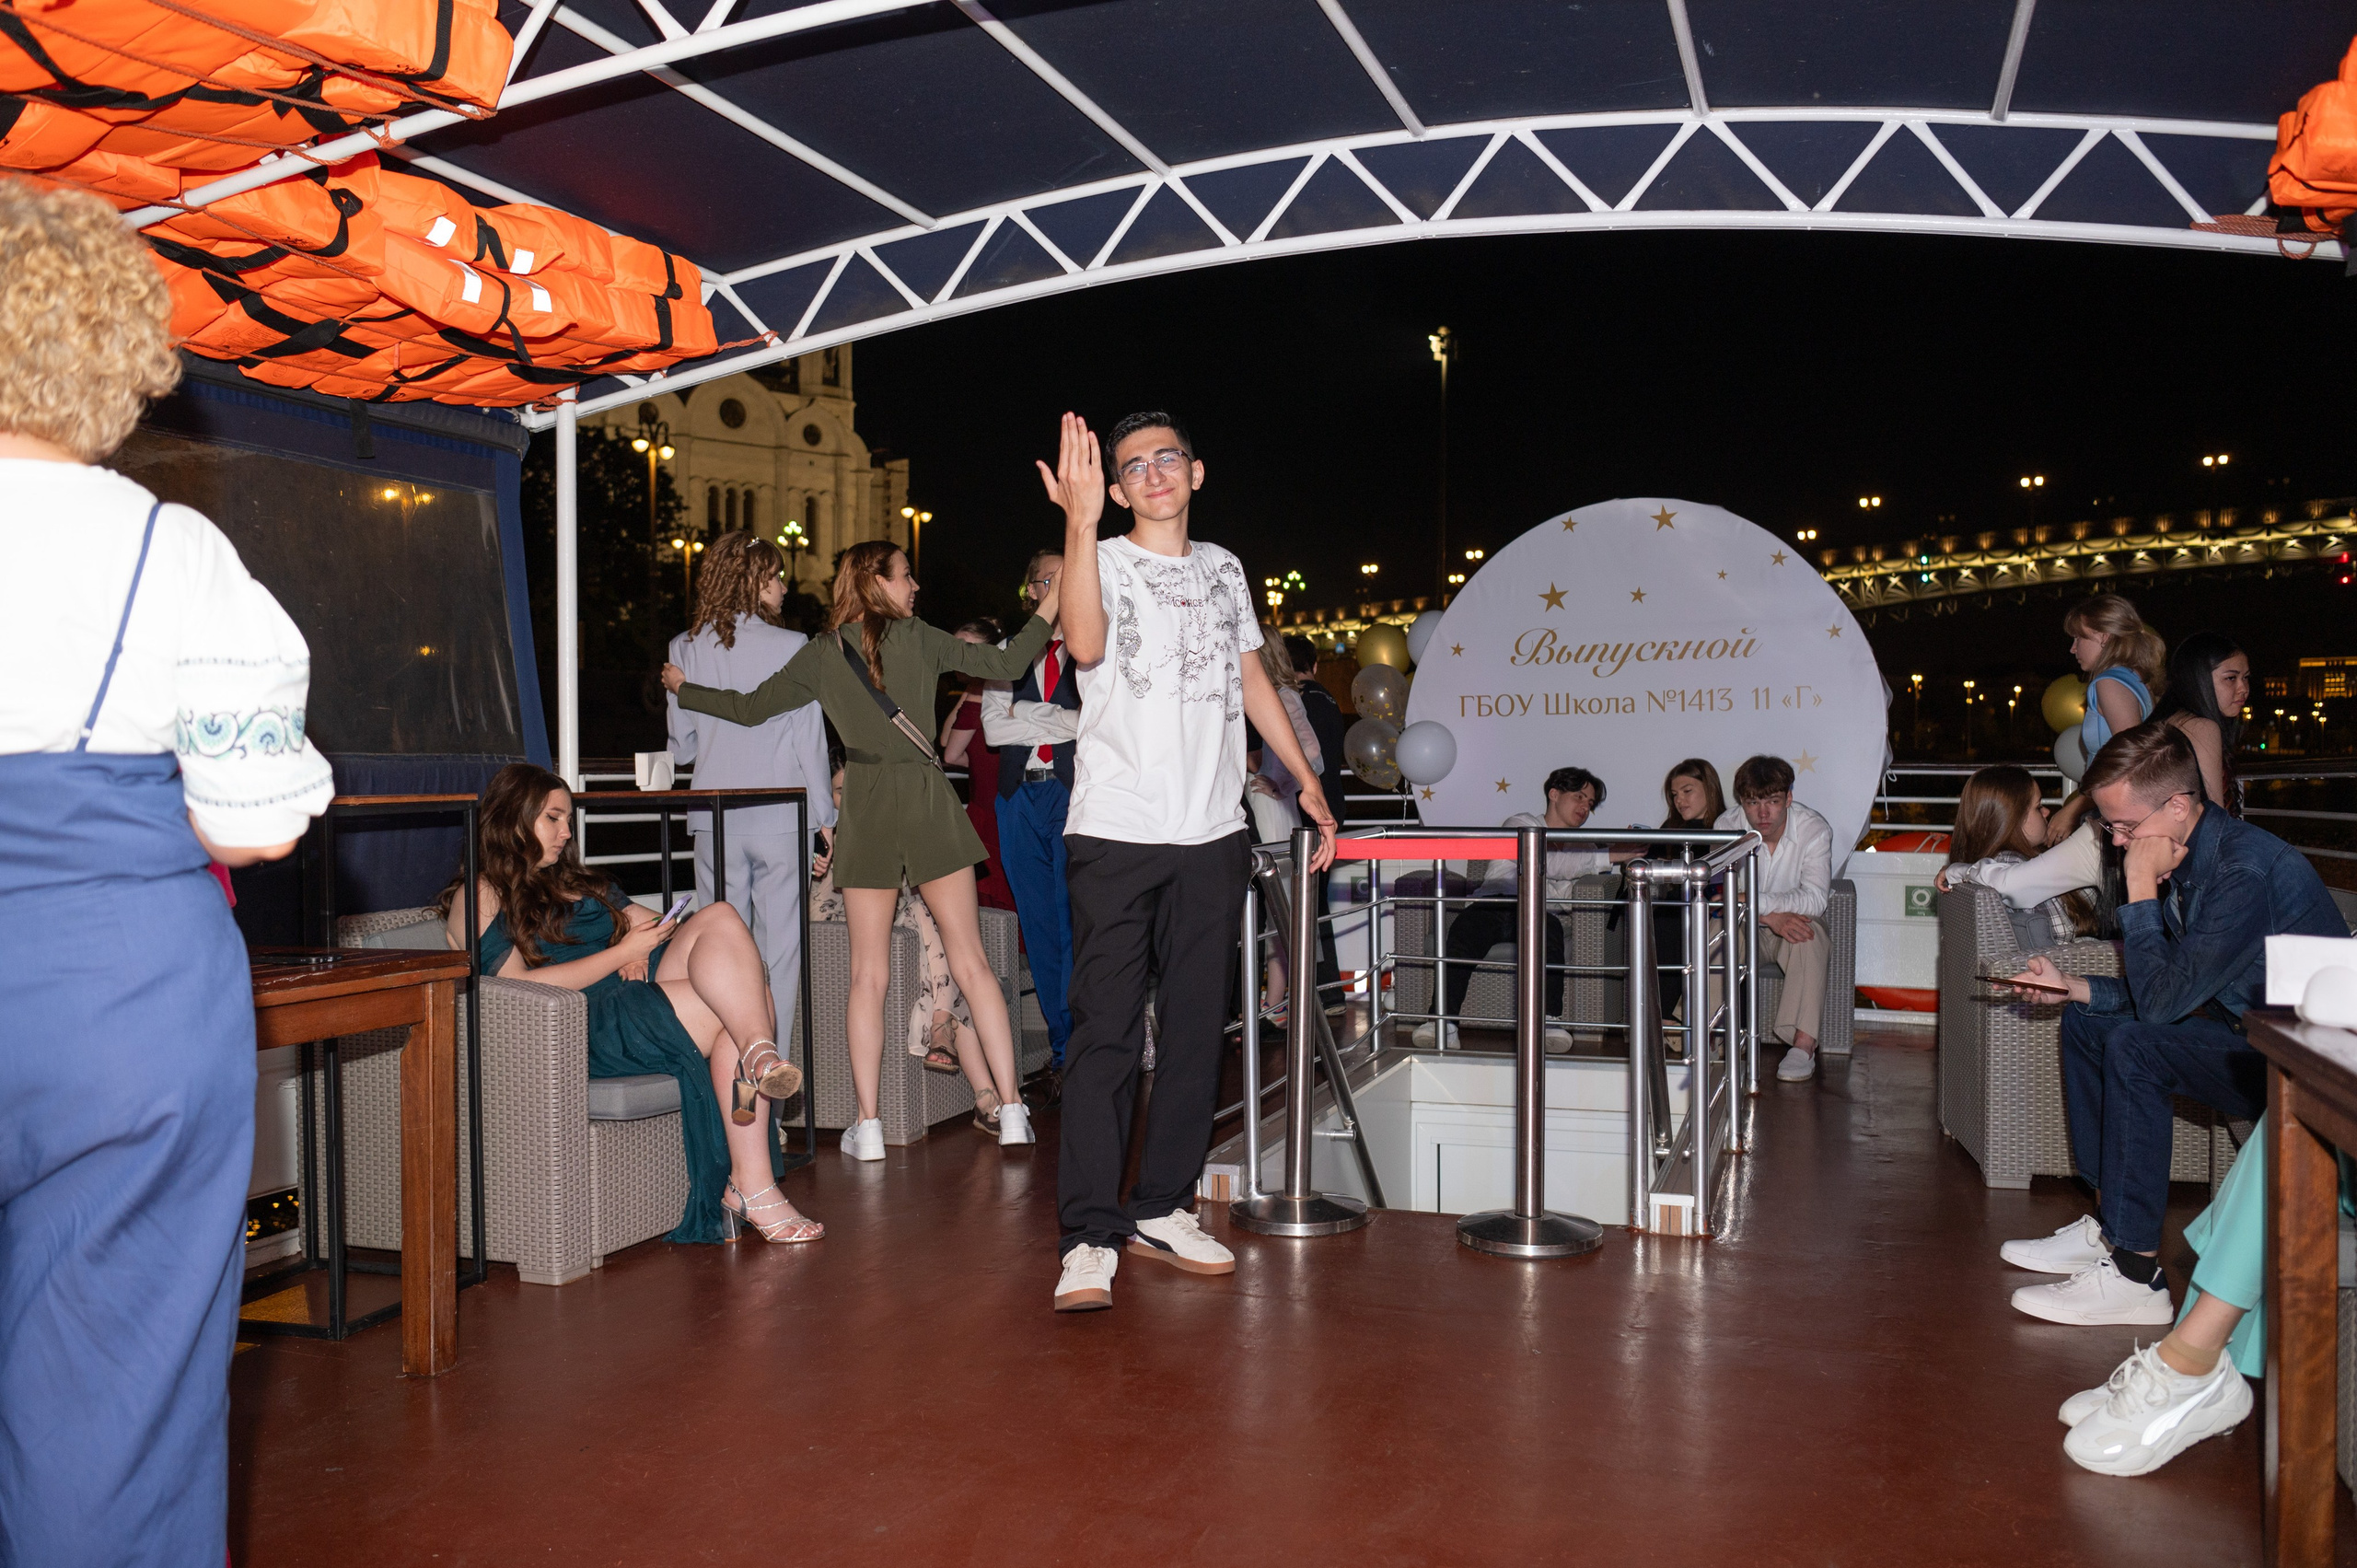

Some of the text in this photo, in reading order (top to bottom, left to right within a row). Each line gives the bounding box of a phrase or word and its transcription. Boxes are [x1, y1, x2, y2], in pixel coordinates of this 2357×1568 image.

[1510, 627, 1763, 678] Выпускной
[1458, 686, 1823, 717] ГБОУ Школа №1413 11 «Г»
